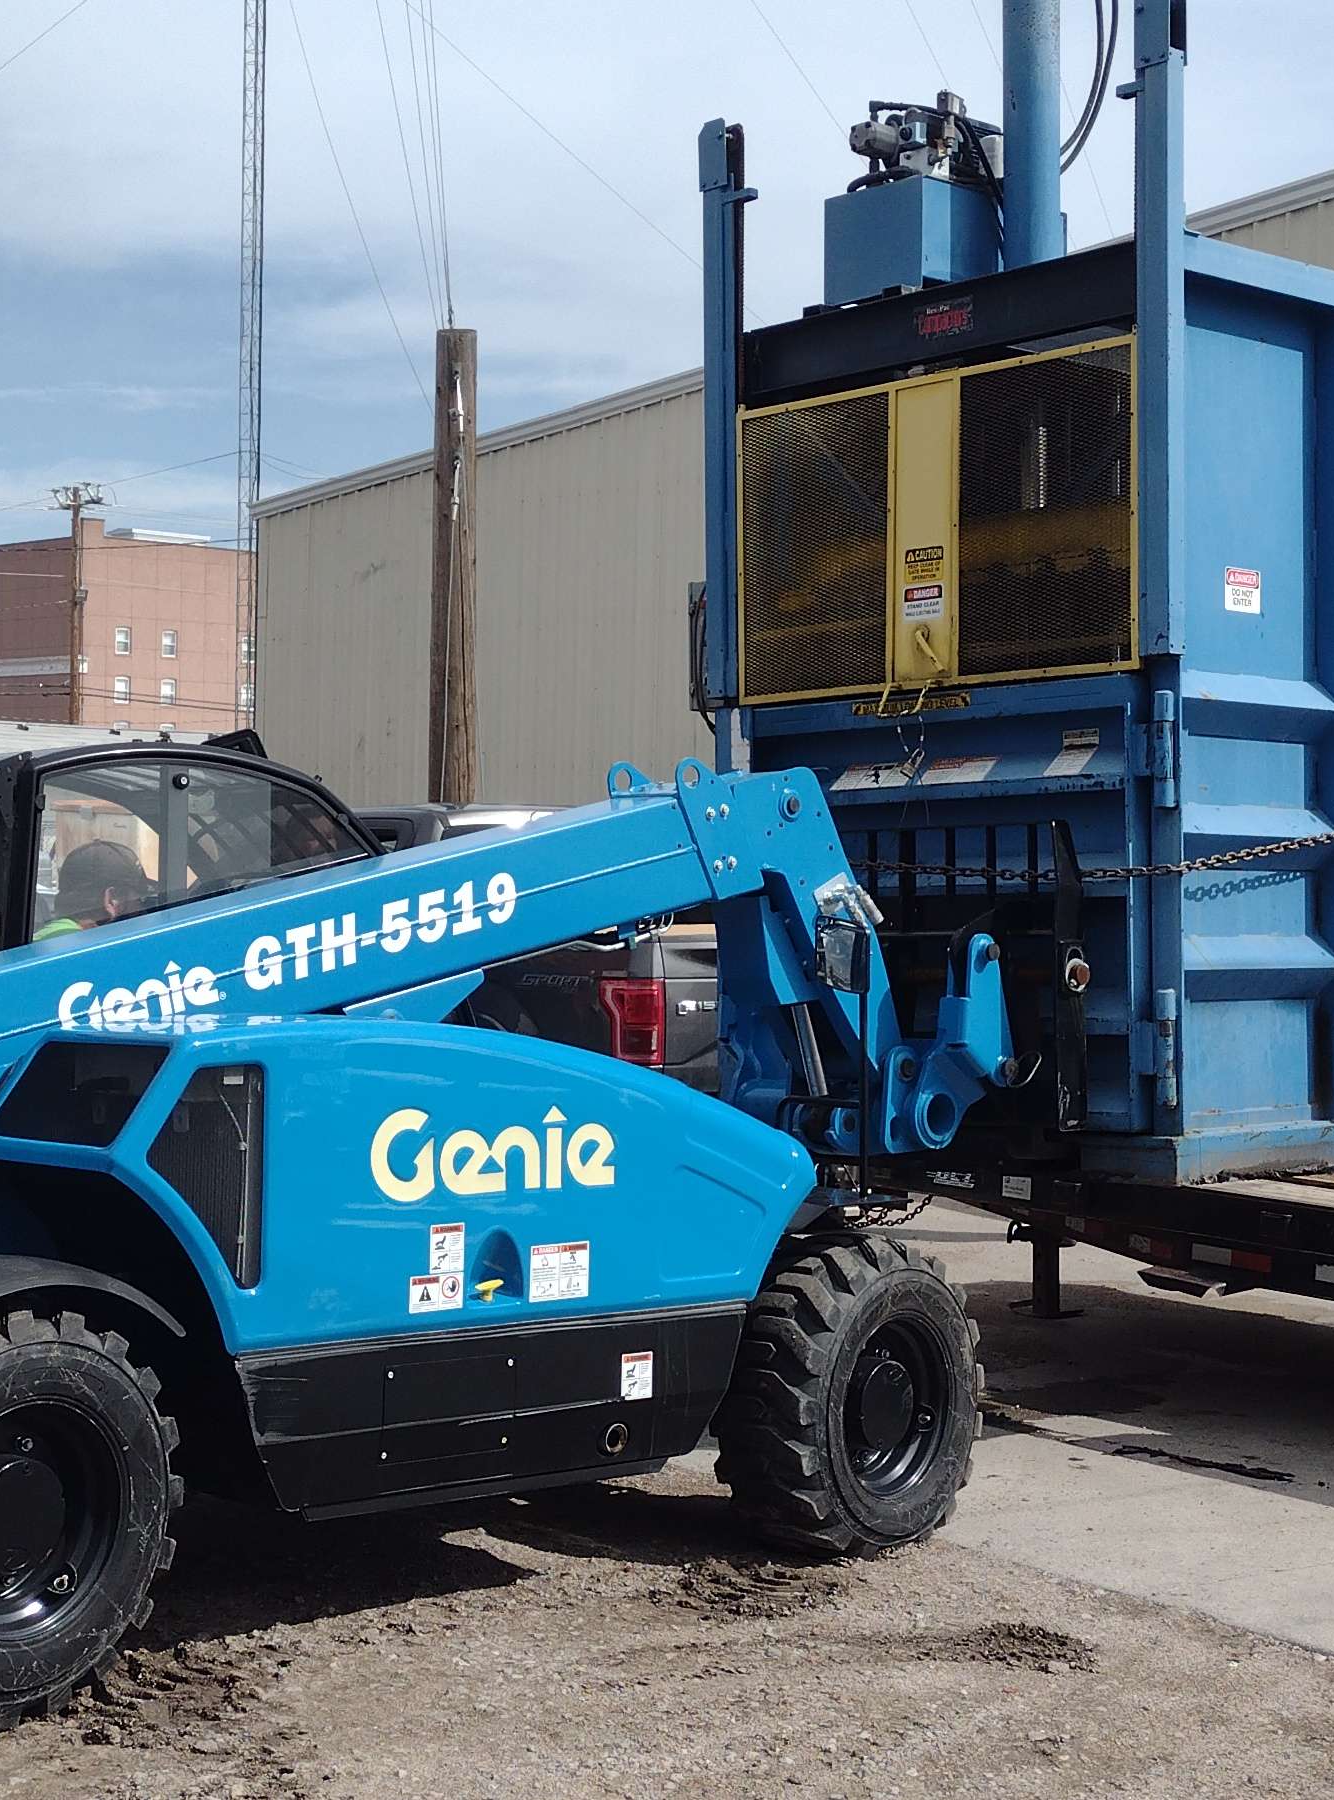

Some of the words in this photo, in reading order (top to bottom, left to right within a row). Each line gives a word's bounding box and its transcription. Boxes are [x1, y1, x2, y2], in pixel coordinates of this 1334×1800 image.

[915, 548, 943, 561] CAUTION
[1234, 572, 1257, 586] DANGER
[914, 587, 939, 599] DANGER
[1231, 587, 1241, 597] DO
[1242, 589, 1254, 599] NOT
[1233, 597, 1252, 607] ENTER
[58, 960, 221, 1030] Genie
[243, 872, 518, 991] GTH-5519
[370, 1105, 616, 1202] Genie
